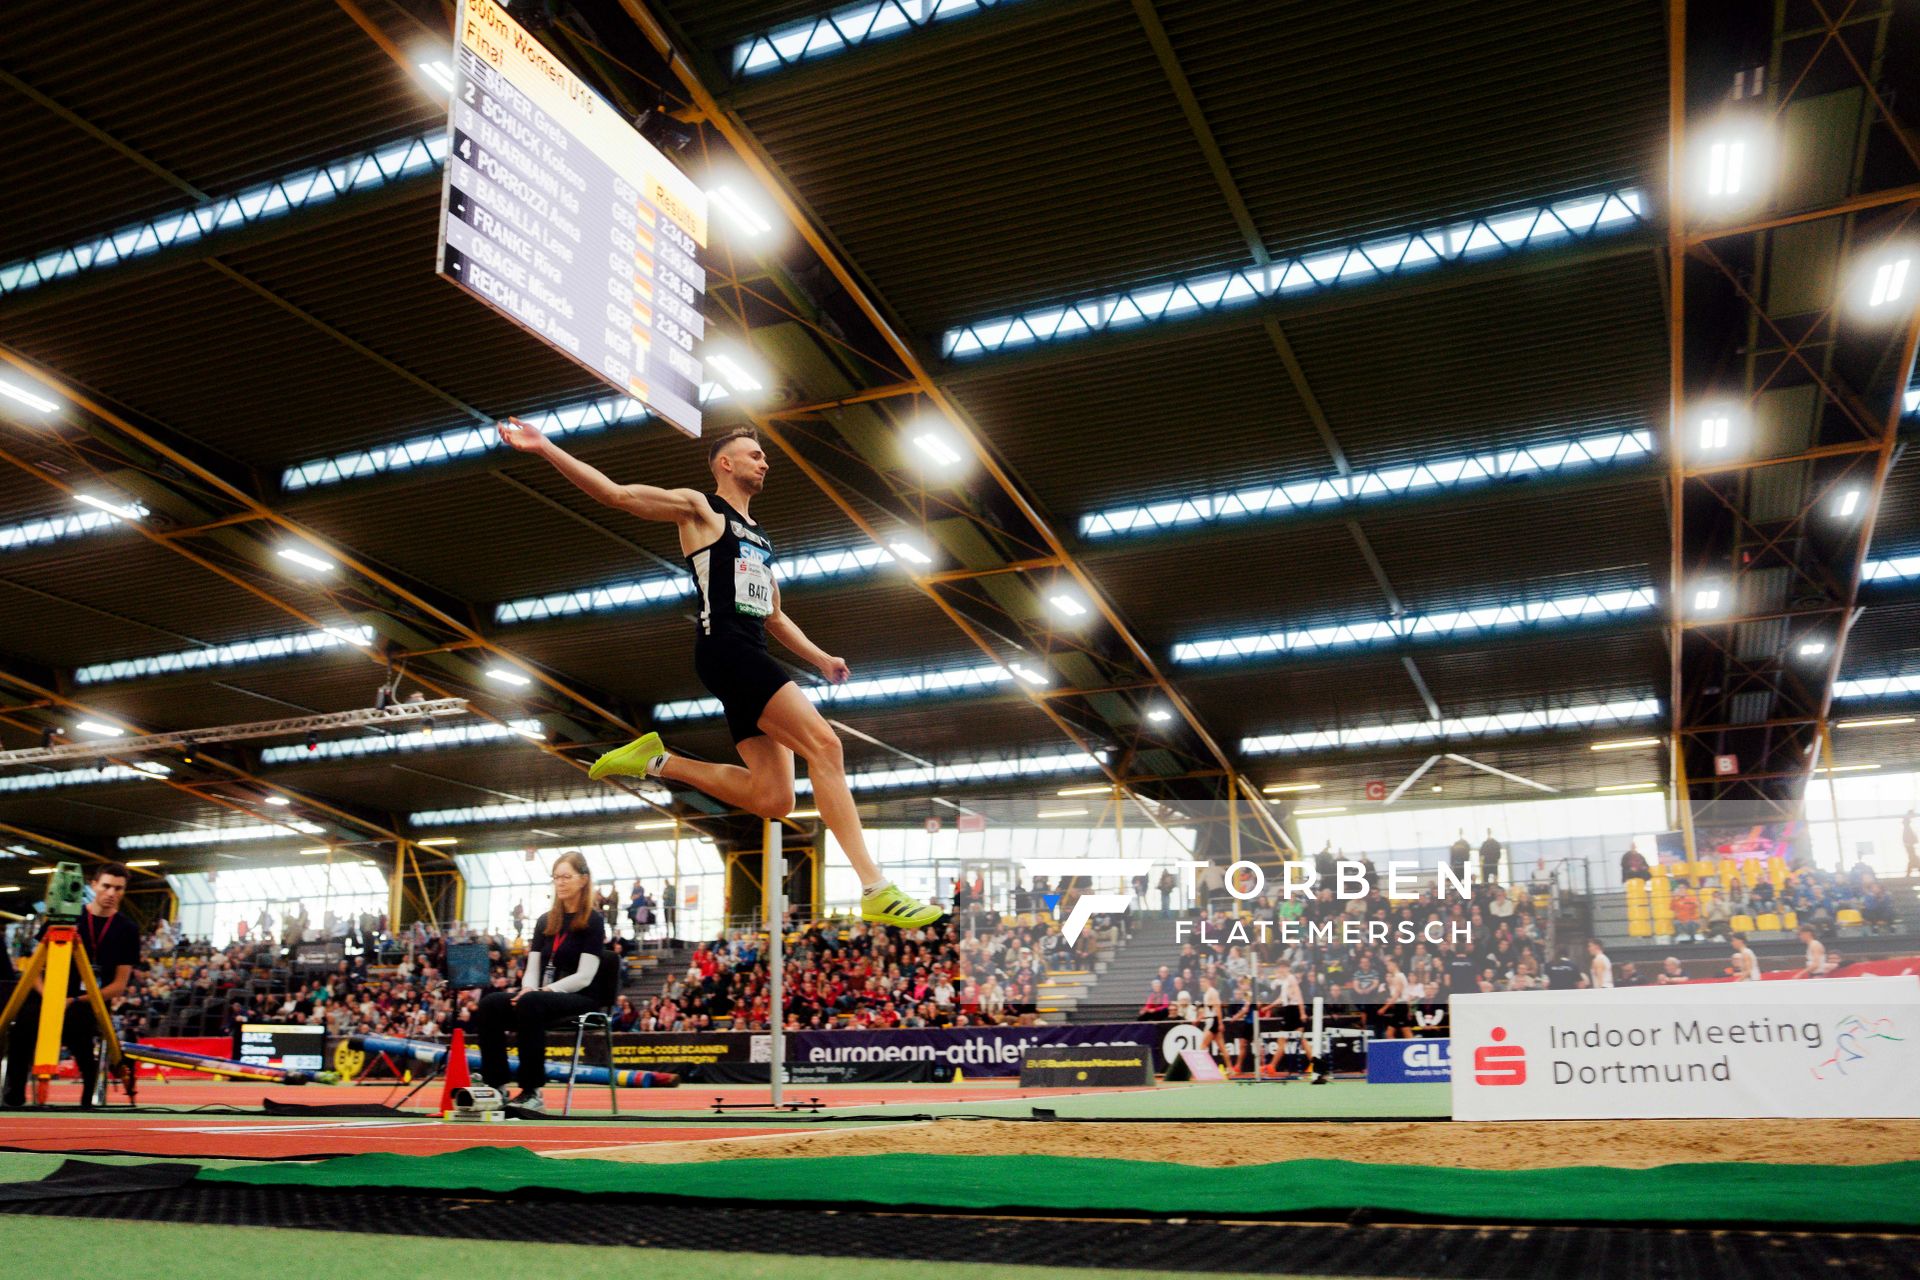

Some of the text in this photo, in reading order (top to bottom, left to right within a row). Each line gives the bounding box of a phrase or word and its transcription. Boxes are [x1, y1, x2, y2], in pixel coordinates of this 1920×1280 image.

[466, 19, 504, 67] Final
[513, 28, 565, 90] Women
[463, 108, 473, 133] 3
[559, 185, 579, 216] Ida
[610, 224, 634, 259] GER
[464, 79, 475, 105] 2
[481, 92, 540, 157] SCHUCK
[612, 199, 636, 235] GER
[533, 108, 568, 152] Greta
[613, 174, 637, 210] GER
[459, 135, 471, 161] 4
[476, 148, 548, 219] PORROZZI
[608, 249, 633, 284] GER
[459, 164, 469, 189] 5
[475, 176, 541, 241] BASALLA
[607, 275, 632, 308] GER
[655, 183, 696, 235] Results
[470, 233, 630, 360] OSAGIE Miracle NGR
[472, 204, 530, 263] FRANKE
[606, 300, 630, 334] GER
[469, 262, 628, 386] REICHLING Anna GER
[748, 582, 768, 602] BATZ
[1370, 783, 1384, 797] C
[1719, 757, 1732, 771] B
[1549, 1017, 1822, 1049] Indoor Meeting
[1553, 1055, 1731, 1085] Dortmund
